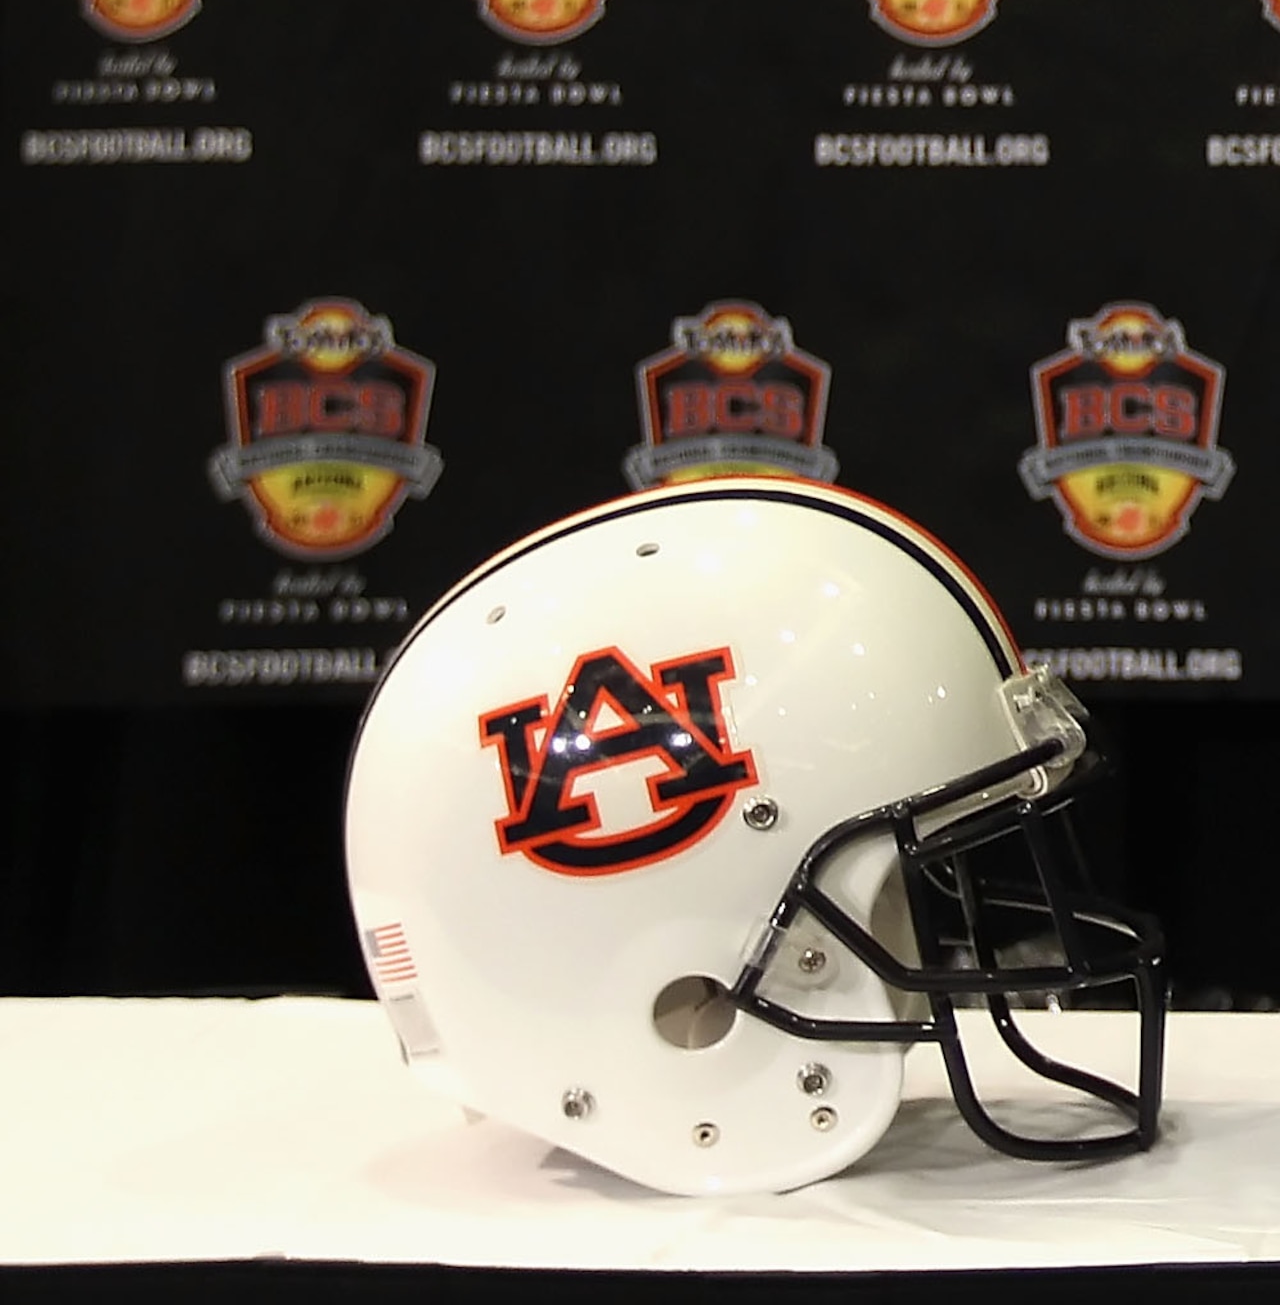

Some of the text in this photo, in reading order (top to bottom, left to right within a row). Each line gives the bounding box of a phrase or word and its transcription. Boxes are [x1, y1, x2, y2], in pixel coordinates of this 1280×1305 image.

[942, 84, 1014, 107] BOWL
[419, 131, 658, 165] BCSFOOTBALL.ORG
[814, 133, 1050, 167] BCSFOOTBALL.ORG
[1063, 383, 1197, 440] BCS
